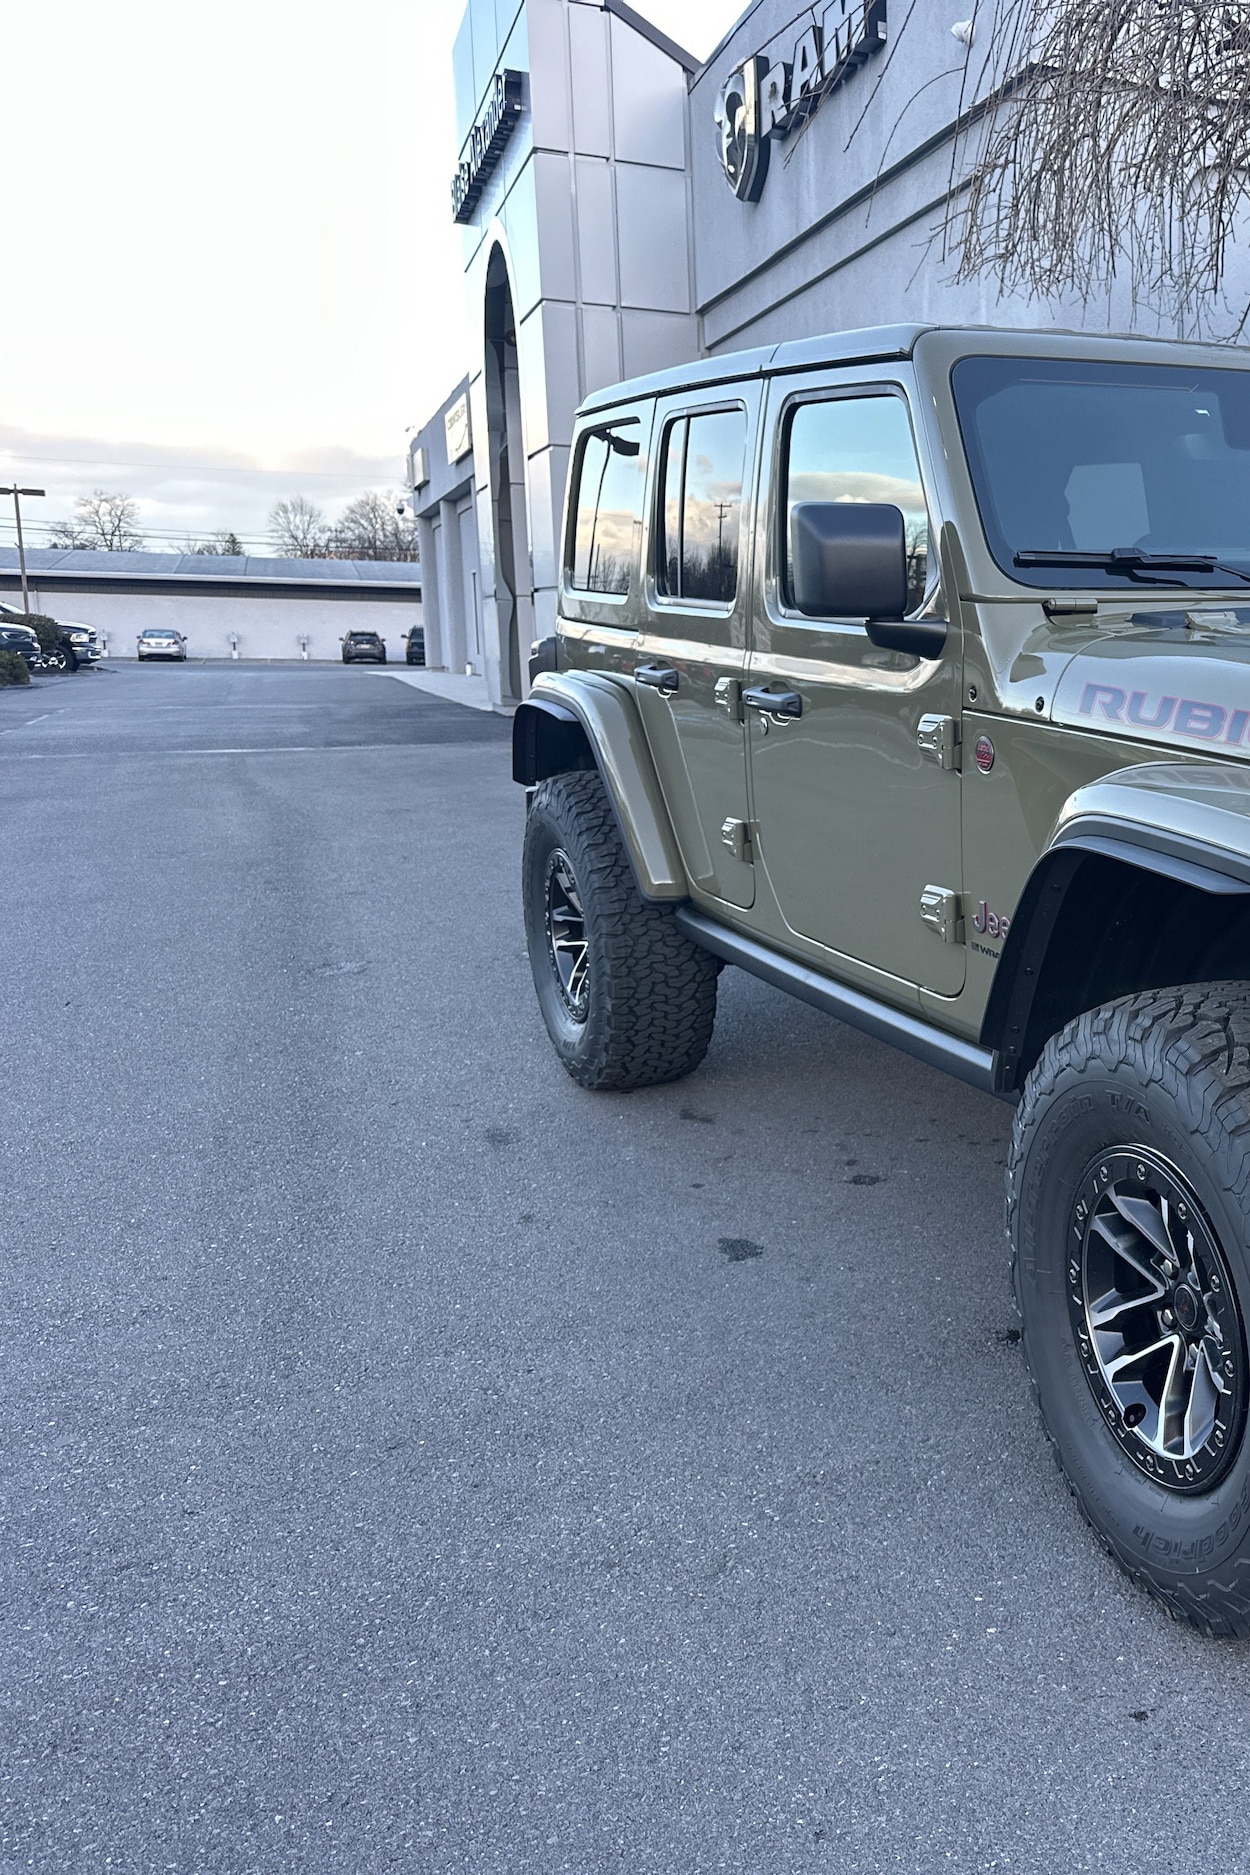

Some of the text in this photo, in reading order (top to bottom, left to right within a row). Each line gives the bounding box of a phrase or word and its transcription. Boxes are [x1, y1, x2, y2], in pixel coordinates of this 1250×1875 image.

[760, 0, 867, 138] RAM
[971, 900, 1010, 940] Jee
[1104, 1089, 1154, 1127] T/A
